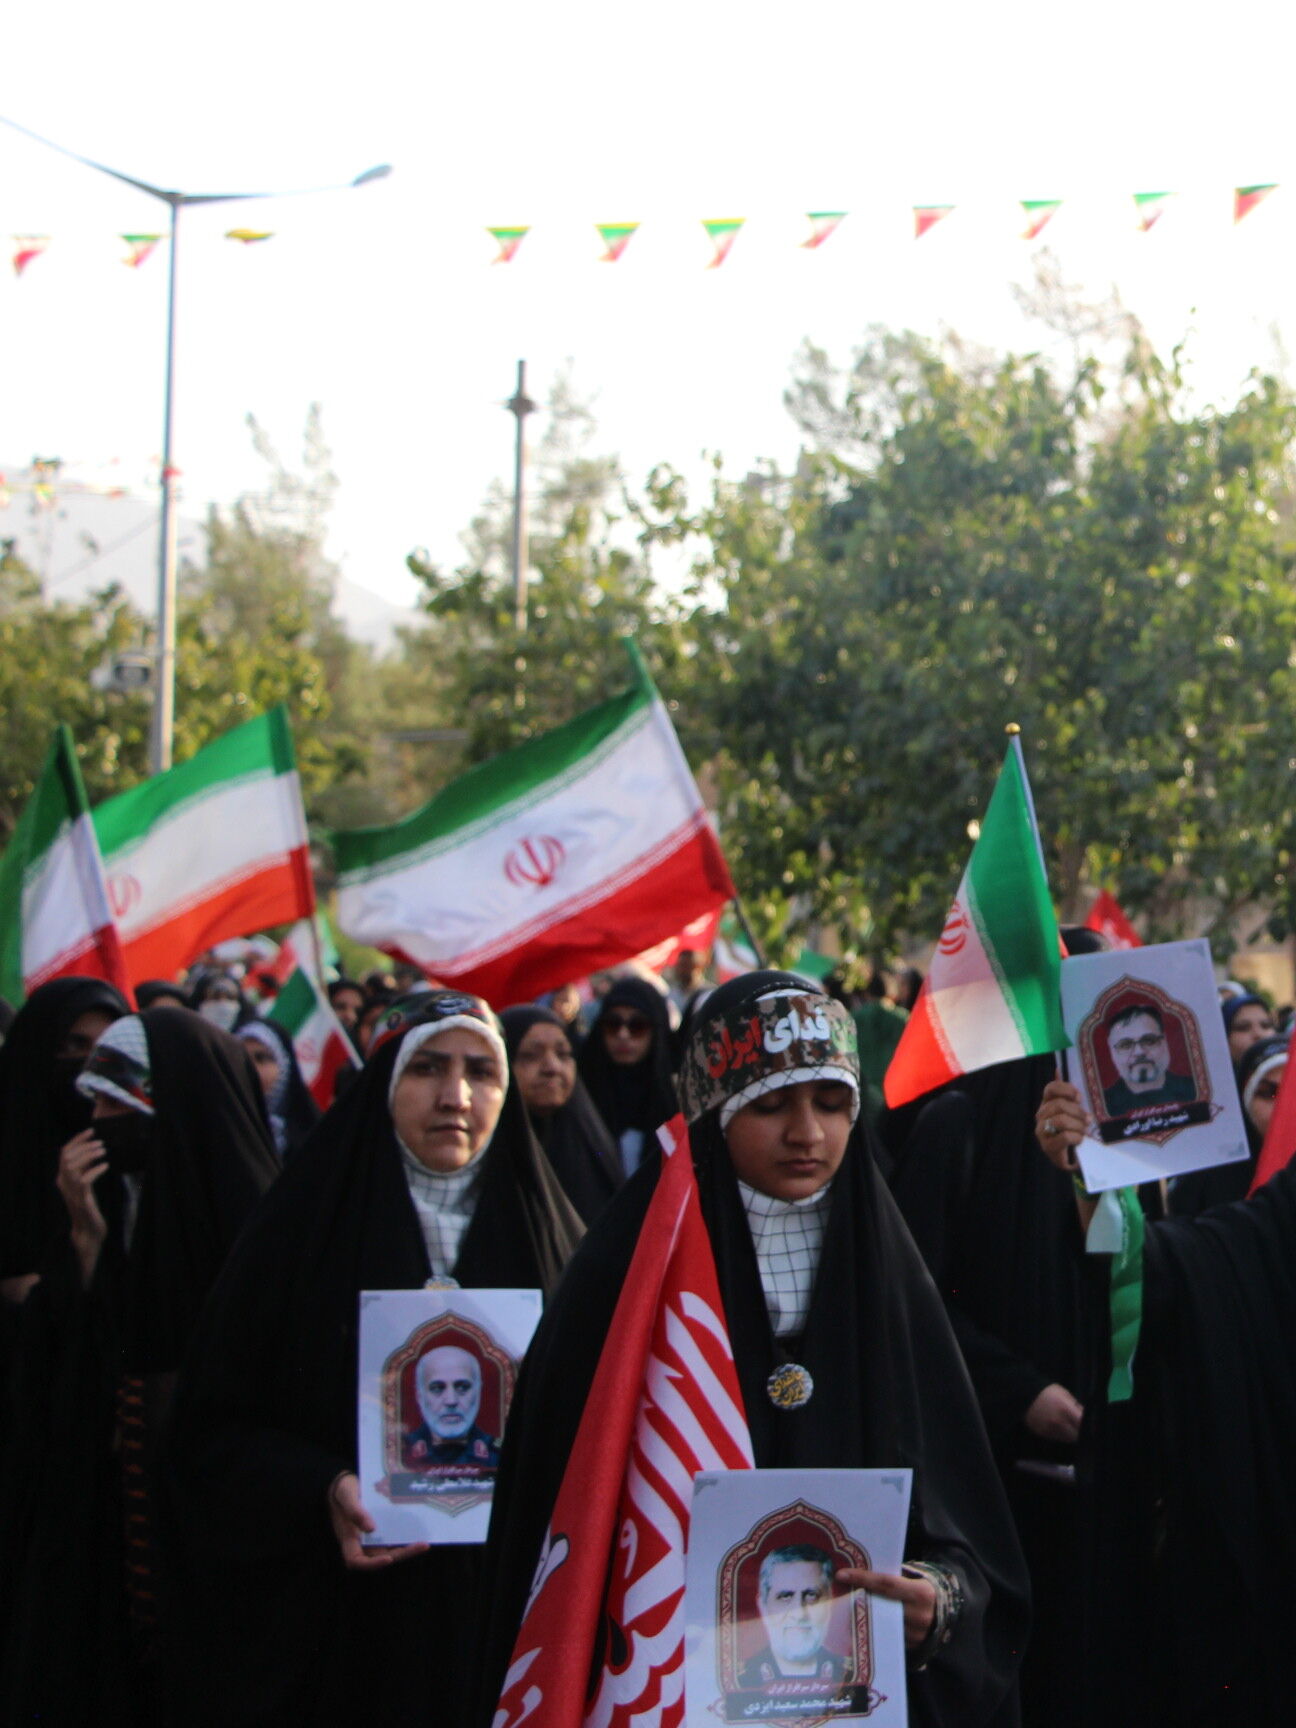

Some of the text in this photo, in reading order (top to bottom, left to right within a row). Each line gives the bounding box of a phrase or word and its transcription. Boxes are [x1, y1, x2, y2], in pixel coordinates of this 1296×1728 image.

[707, 1016, 762, 1079] ایران
[764, 1006, 830, 1053] فدای
[744, 1694, 851, 1715] شهید محمد سعید ایزدی
